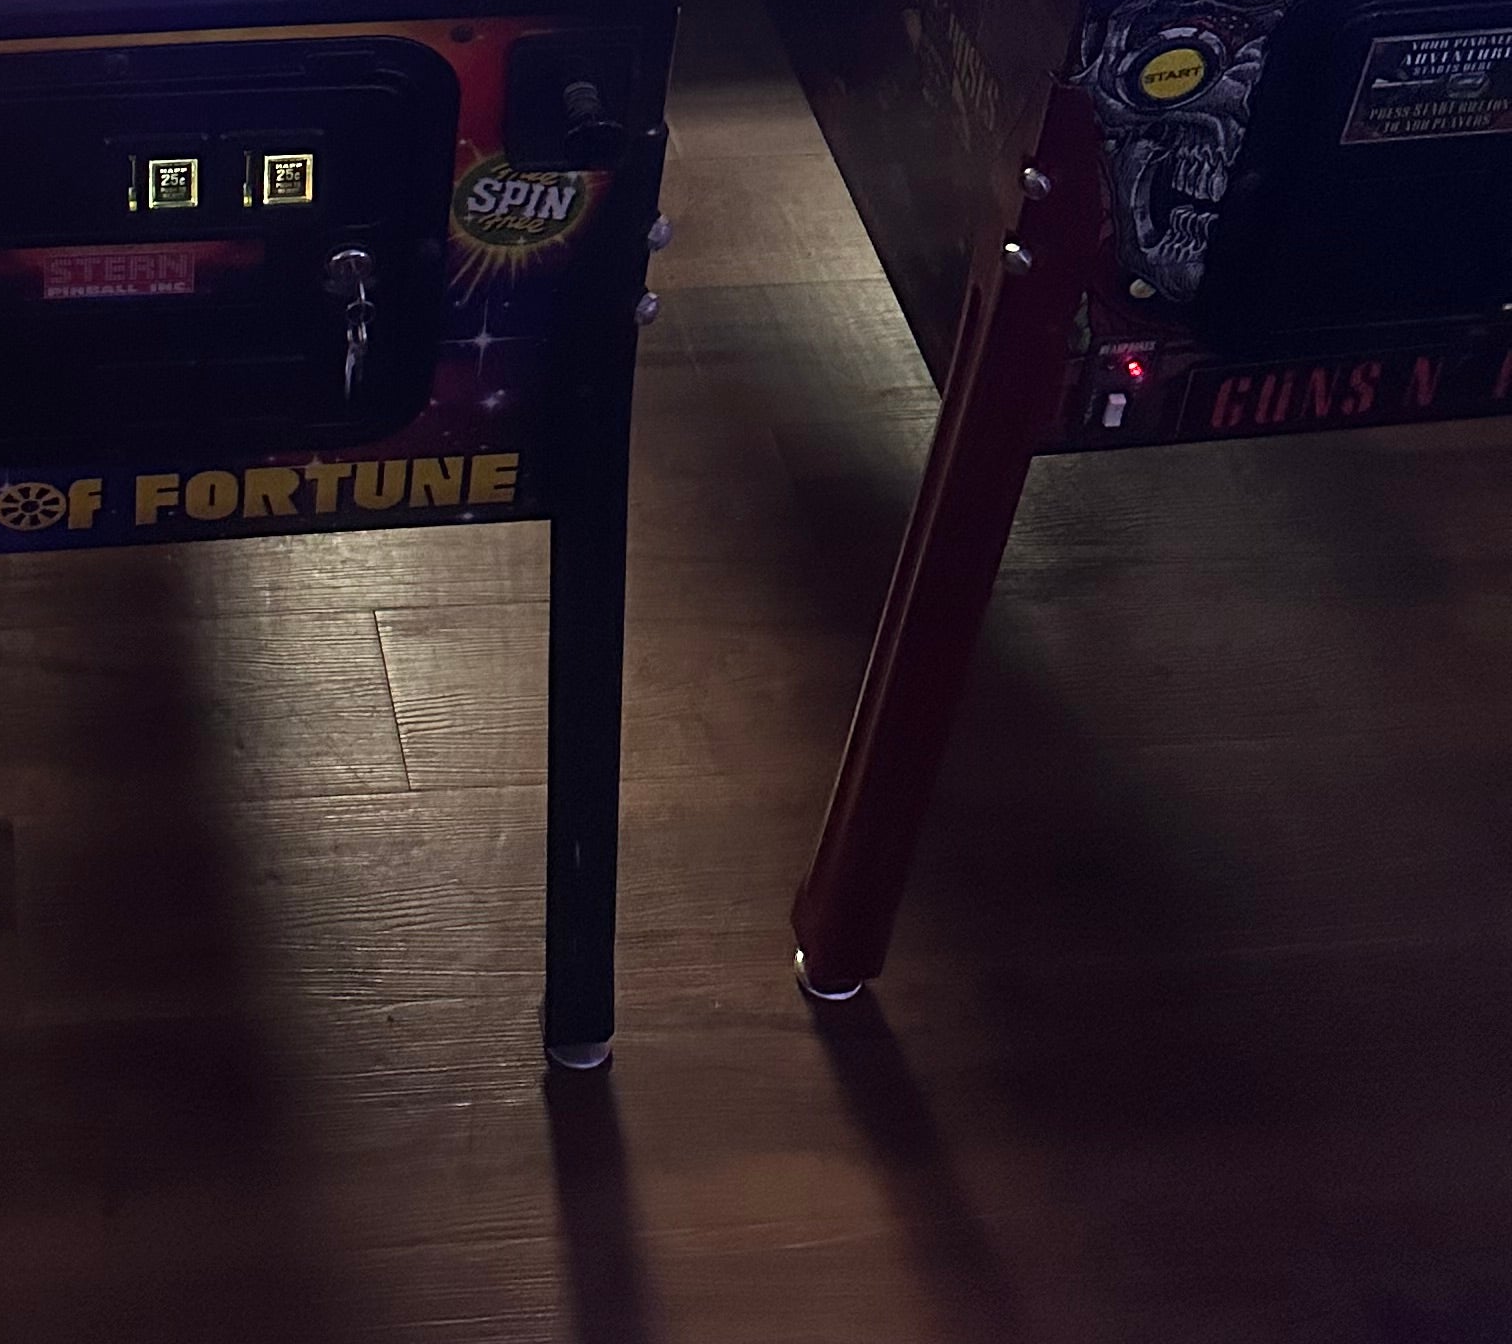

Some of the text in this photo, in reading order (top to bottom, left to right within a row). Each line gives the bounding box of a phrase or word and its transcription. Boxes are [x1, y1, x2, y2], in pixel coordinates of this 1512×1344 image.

[1144, 65, 1202, 84] START
[468, 177, 577, 221] SPIN
[46, 254, 189, 283] STERN
[47, 284, 139, 297] PINBALL
[1210, 358, 1383, 430] GUNS
[135, 452, 521, 526] FORTUNE
